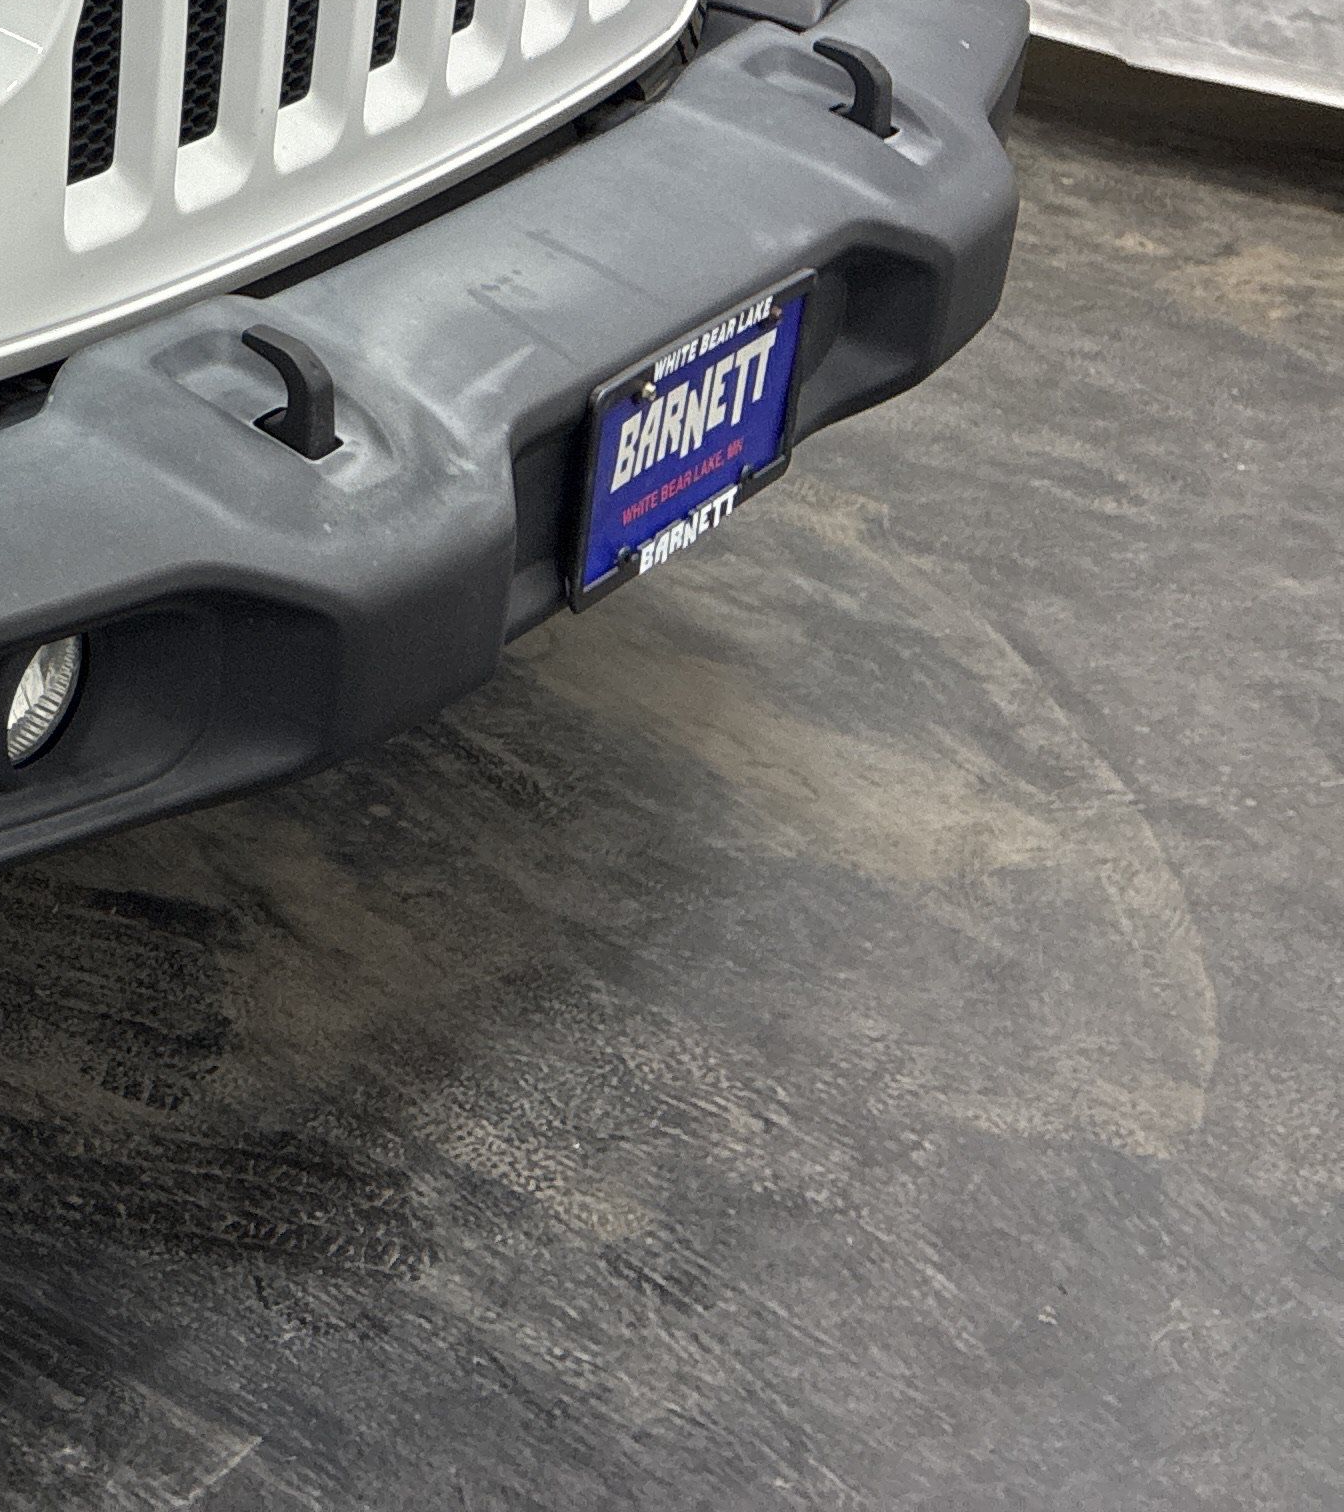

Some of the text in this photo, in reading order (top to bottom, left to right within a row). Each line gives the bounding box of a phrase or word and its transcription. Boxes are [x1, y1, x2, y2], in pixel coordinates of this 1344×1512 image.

[654, 295, 773, 382] WHITE BEAR LAKE
[611, 328, 776, 493] BARNETT
[622, 490, 658, 527] WHITE
[661, 469, 693, 503] BEAR
[639, 486, 738, 576] BARNETT
